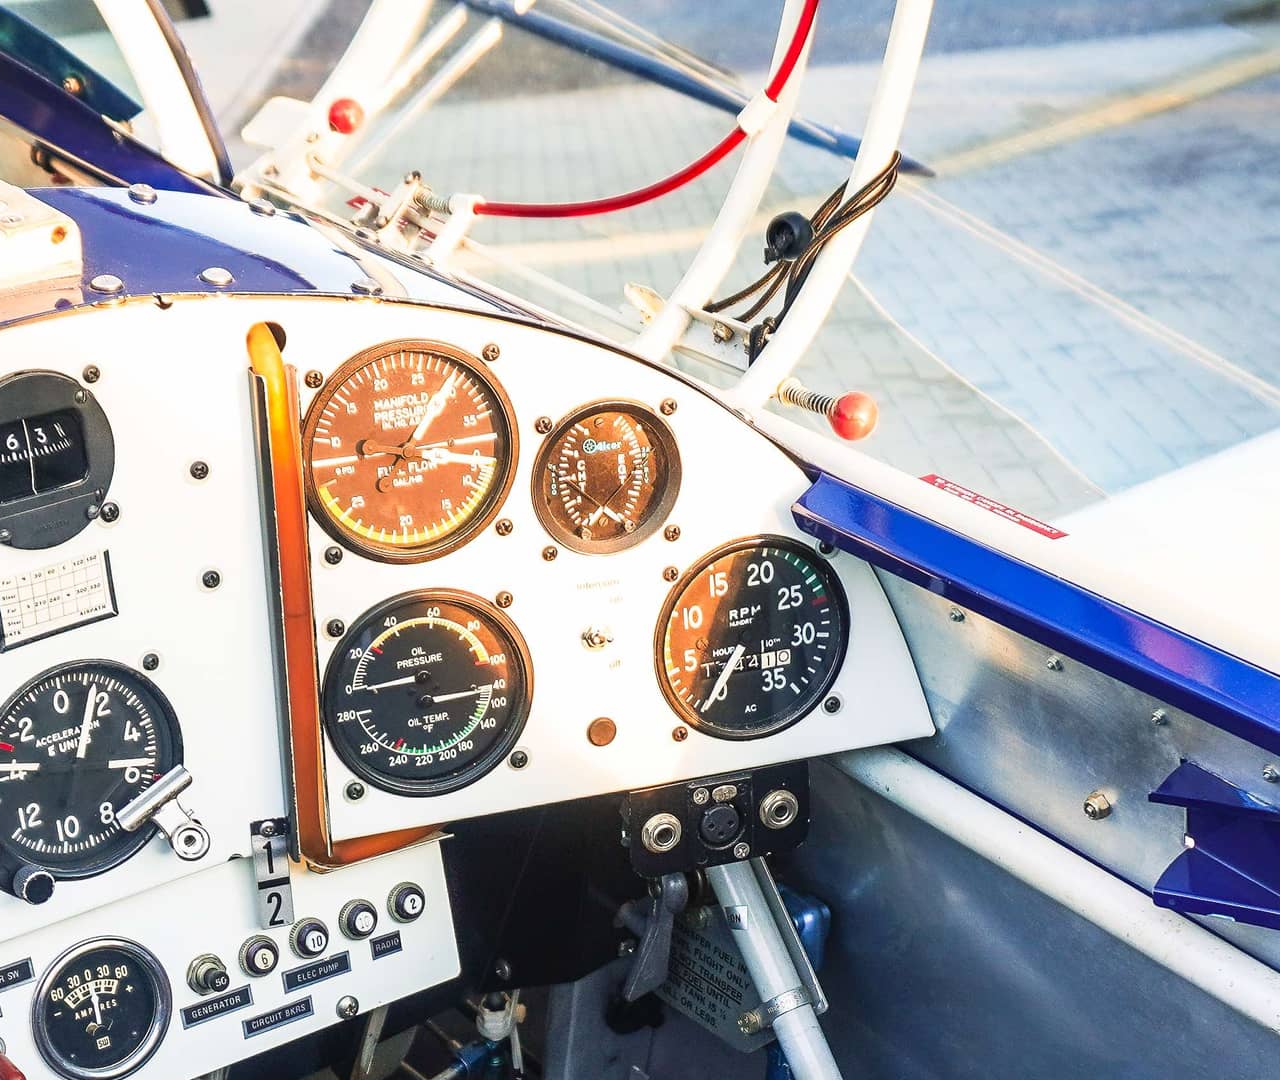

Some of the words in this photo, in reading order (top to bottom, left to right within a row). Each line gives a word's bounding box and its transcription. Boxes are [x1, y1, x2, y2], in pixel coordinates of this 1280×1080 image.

[373, 378, 389, 392] 20
[411, 373, 425, 385] 25
[373, 391, 429, 411] MANIFOLD
[347, 402, 358, 416] 15
[463, 413, 477, 427] 35
[6, 433, 19, 450] 6
[34, 428, 47, 443] 3
[330, 436, 342, 448] 10
[392, 475, 424, 488] GAL/HR
[462, 475, 472, 486] 10
[351, 496, 365, 508] 25
[441, 498, 452, 510] 15
[399, 514, 413, 526] 20
[747, 561, 774, 587] 20
[709, 572, 728, 597] 15
[777, 584, 803, 611] 25
[426, 606, 440, 617] 60
[683, 605, 703, 630] 10
[729, 604, 761, 621] RPM
[383, 616, 397, 628] 40
[467, 620, 481, 631] 80
[791, 622, 815, 647] 30
[350, 648, 363, 660] 20
[411, 646, 426, 657] OIL
[396, 653, 443, 670] PRESSURE
[489, 653, 506, 665] 100
[684, 650, 697, 671] 5
[493, 679, 506, 690] 40
[761, 668, 786, 692] 35
[345, 684, 352, 695] 0
[53, 690, 69, 714] 0
[95, 691, 111, 716] 2
[490, 696, 507, 709] 100
[744, 704, 758, 714] AC
[336, 709, 356, 723] 280
[407, 716, 422, 728] OIL
[479, 717, 496, 730] 140
[123, 720, 141, 742] 4
[360, 742, 380, 755] 260
[457, 739, 474, 752] 180
[388, 754, 408, 767] 240
[415, 753, 433, 766] 220
[438, 748, 457, 761] 200
[18, 802, 42, 830] 12
[99, 801, 114, 824] 8
[56, 815, 80, 842] 10
[262, 841, 274, 874] 1
[267, 892, 284, 926] 2
[410, 898, 417, 910] 2
[311, 935, 323, 948] 10
[375, 938, 399, 952] RADIO
[7, 969, 20, 981] SW
[84, 969, 92, 981] 0
[96, 964, 110, 978] 30
[115, 965, 128, 979] 60
[297, 968, 317, 982] ELEC
[318, 961, 339, 975] PUMP
[67, 974, 80, 989] 30
[726, 971, 750, 989] ONLY
[50, 987, 64, 1002] 60
[75, 999, 117, 1020] AMPRES
[191, 994, 241, 1019] GENERATOR
[251, 1011, 284, 1030] CIRCUIT
[285, 1003, 307, 1018] BKRS
